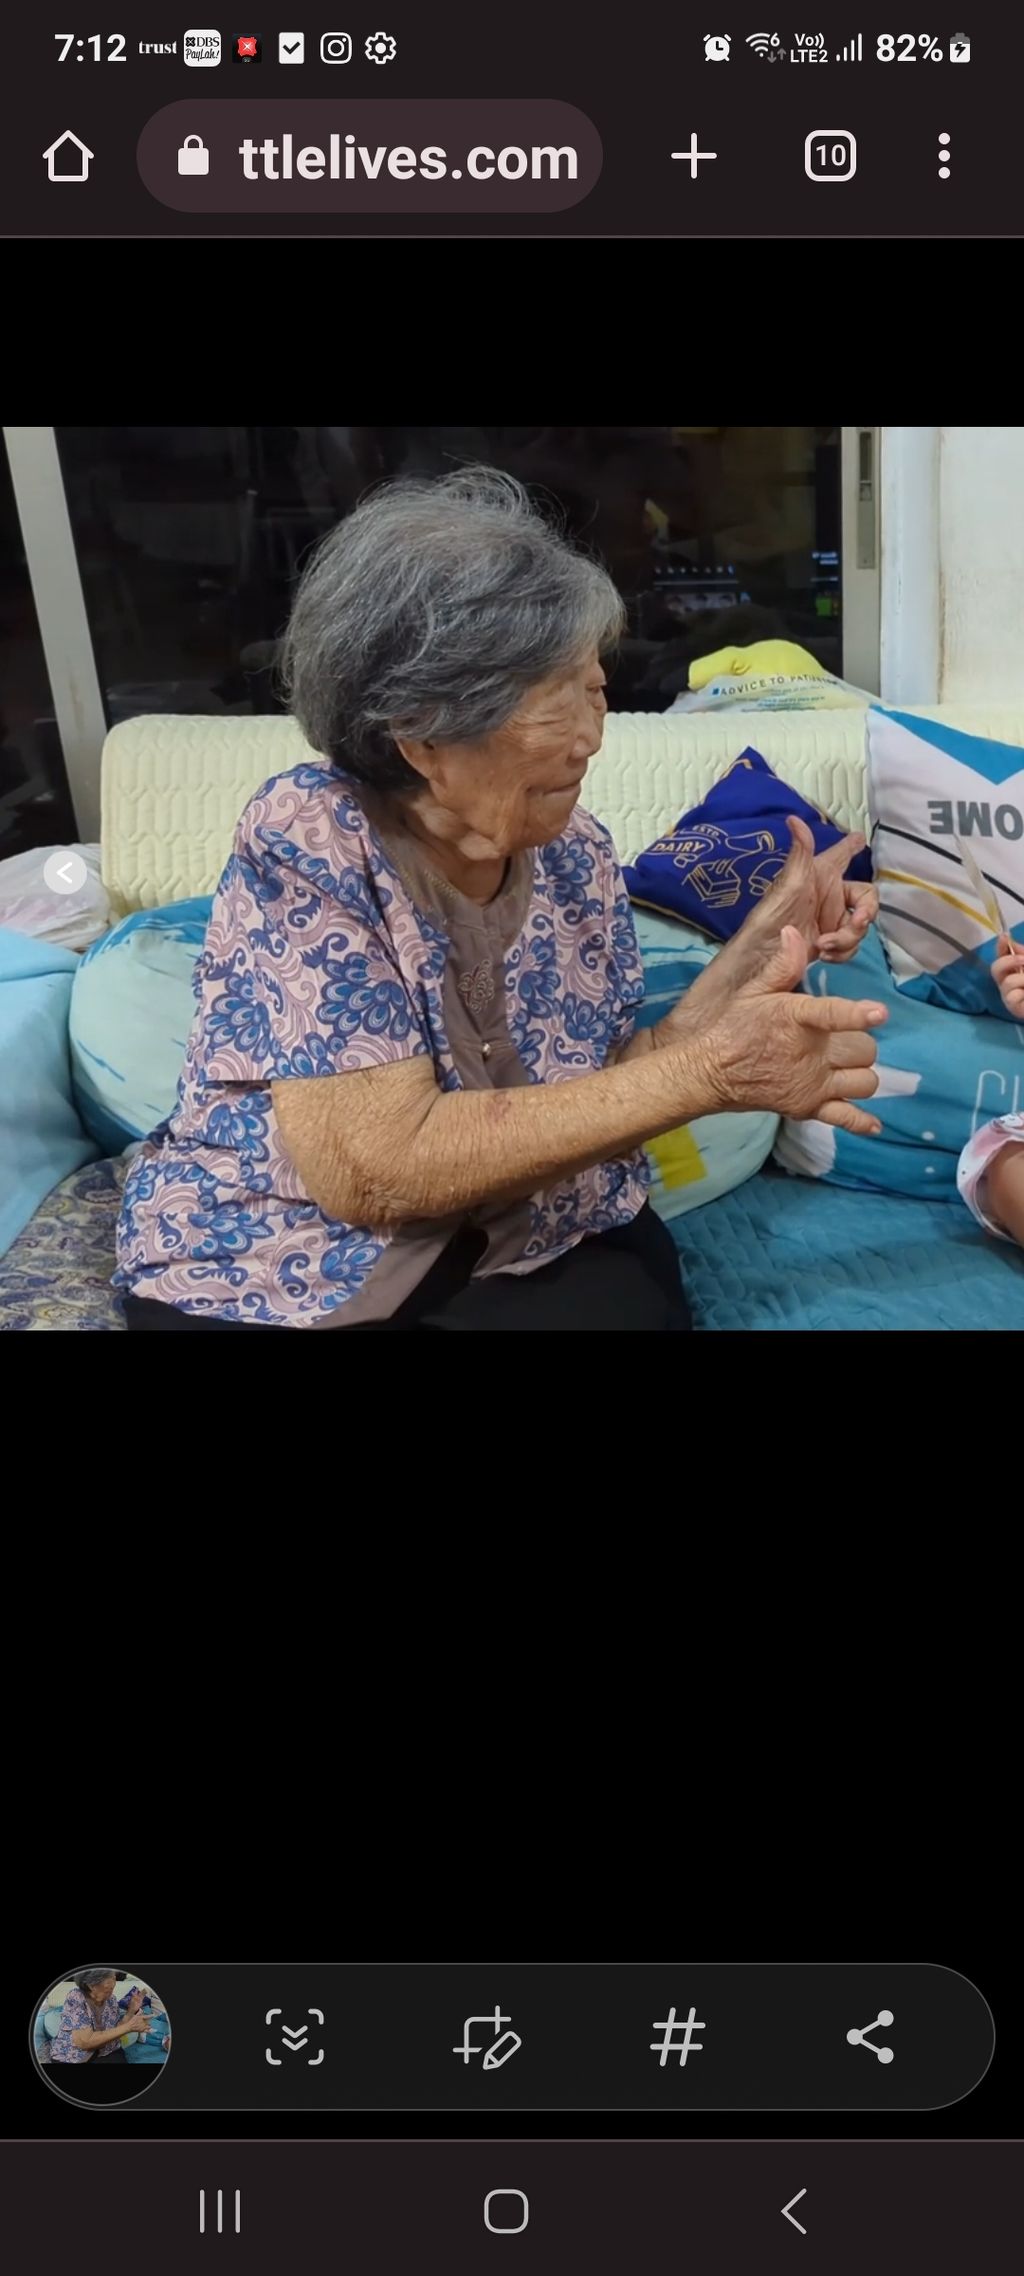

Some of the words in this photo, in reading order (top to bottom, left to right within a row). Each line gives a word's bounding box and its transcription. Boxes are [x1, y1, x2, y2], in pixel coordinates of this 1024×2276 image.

[54, 34, 127, 62] 7:12
[138, 41, 177, 54] trust
[196, 37, 220, 48] DBS
[876, 34, 944, 62] 82%
[185, 48, 220, 62] PayLah!
[790, 49, 829, 63] LTE2
[239, 134, 578, 180] ttlelives.com
[815, 144, 847, 166] 10
[720, 680, 767, 696] ADVICE
[770, 676, 785, 685] TO
[651, 841, 706, 853] DAIRY
